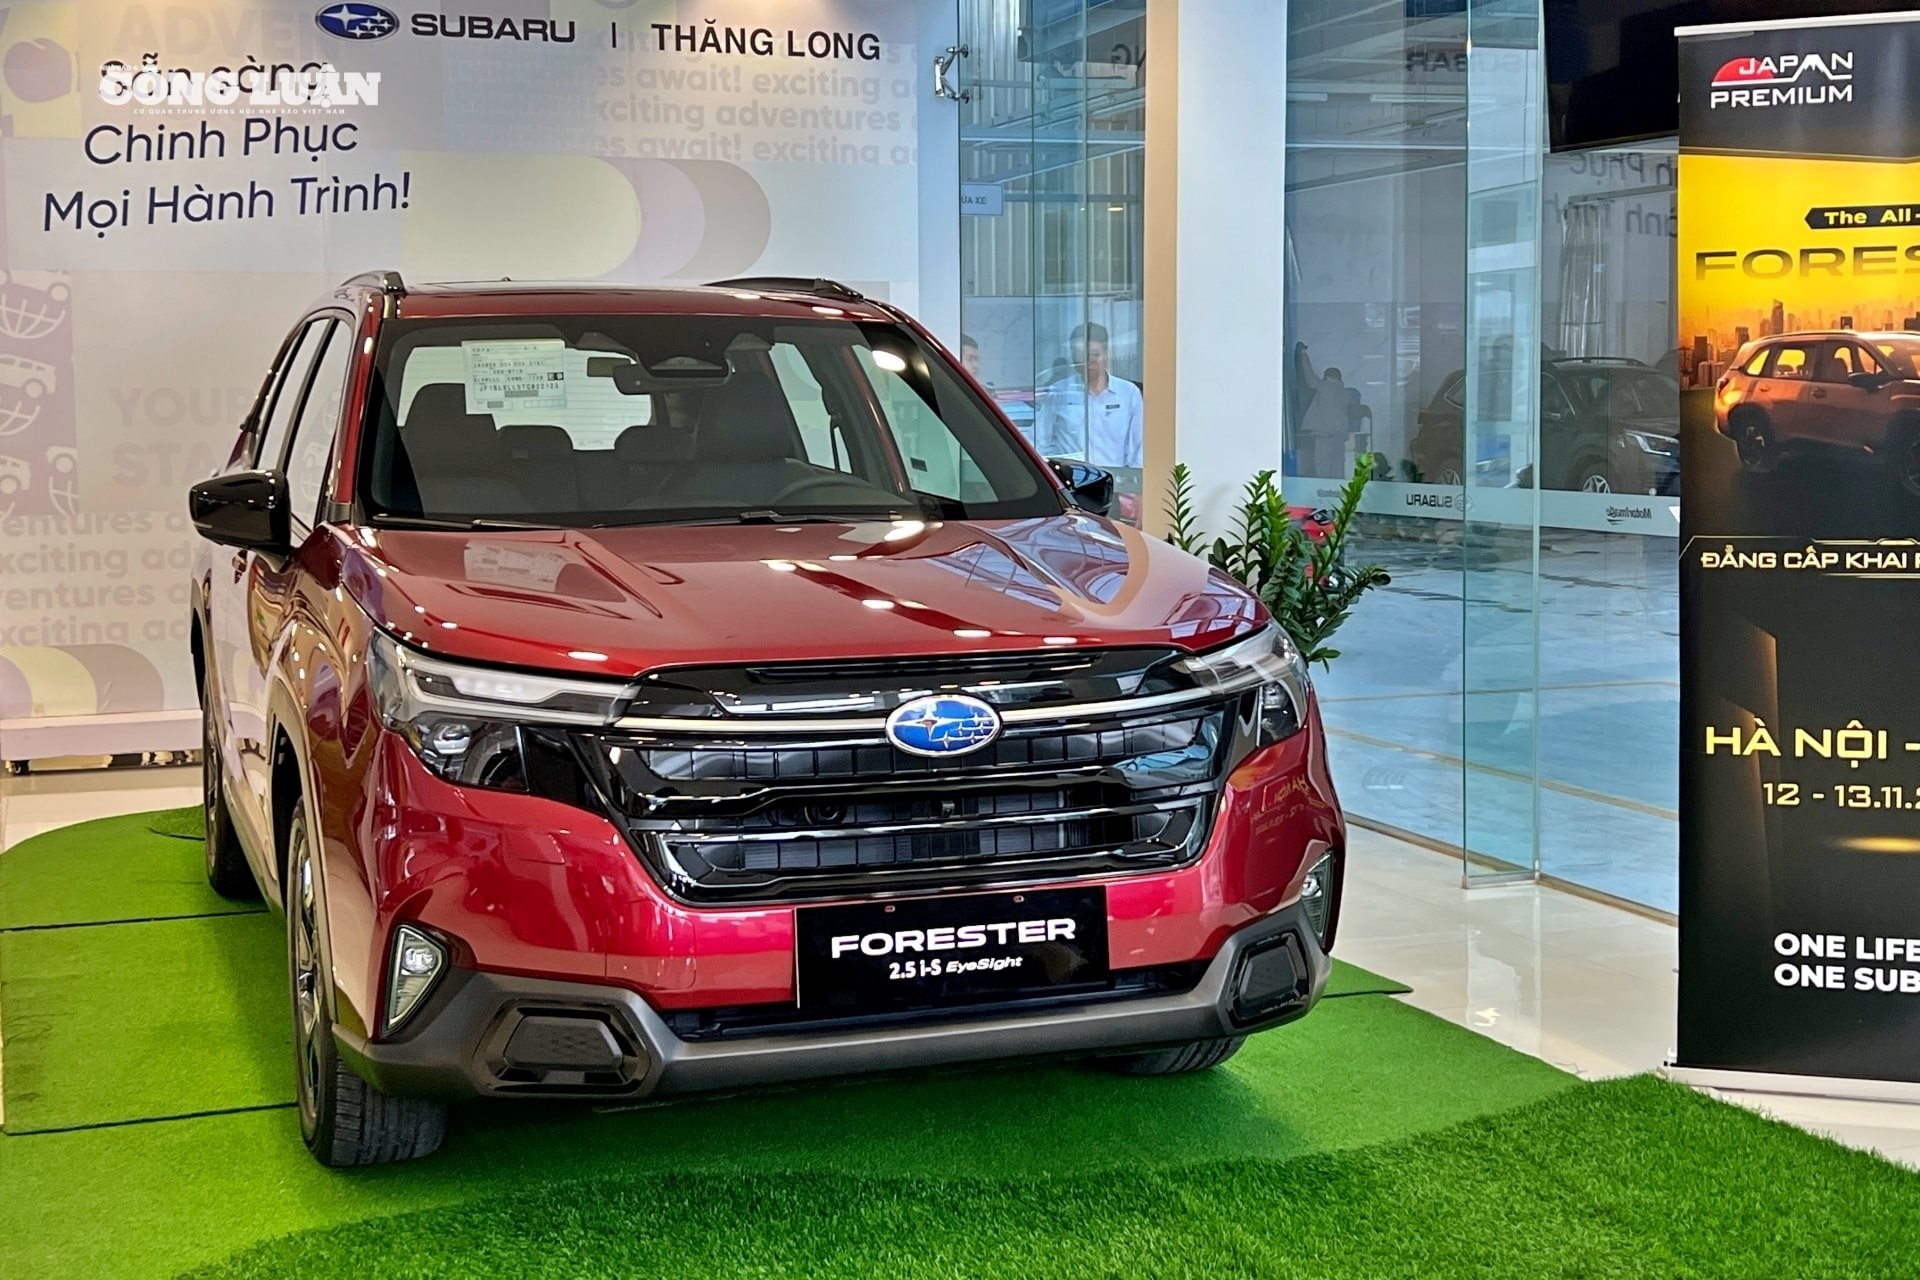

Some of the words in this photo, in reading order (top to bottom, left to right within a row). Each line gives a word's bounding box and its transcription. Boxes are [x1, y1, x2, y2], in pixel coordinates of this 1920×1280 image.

[411, 13, 576, 43] SUBARU
[651, 18, 774, 56] THĂNG
[787, 30, 881, 60] LONG
[1738, 52, 1854, 76] JAPAN
[752, 70, 881, 105] exciting
[1711, 84, 1853, 109] PREMIUM
[716, 101, 900, 131] adventures
[84, 120, 226, 165] Chinh
[243, 117, 359, 163] Phục
[43, 189, 130, 239] Mọi
[147, 180, 274, 225] Hành
[291, 171, 411, 216] Trình!
[1824, 210, 1868, 225] The
[1846, 552, 1907, 569] KHAI
[1705, 717, 1781, 757] HÀ
[1795, 720, 1887, 768] NỘI
[1763, 783, 1800, 805] 12
[1834, 785, 1920, 809] 13.11.
[831, 917, 1077, 958] FORESTER
[1774, 932, 1847, 958] ONE
[1856, 936, 1920, 962] LIFE
[889, 961, 917, 980] 2.5
[946, 956, 1023, 974] EyeSight
[1774, 963, 1846, 989] ONE
